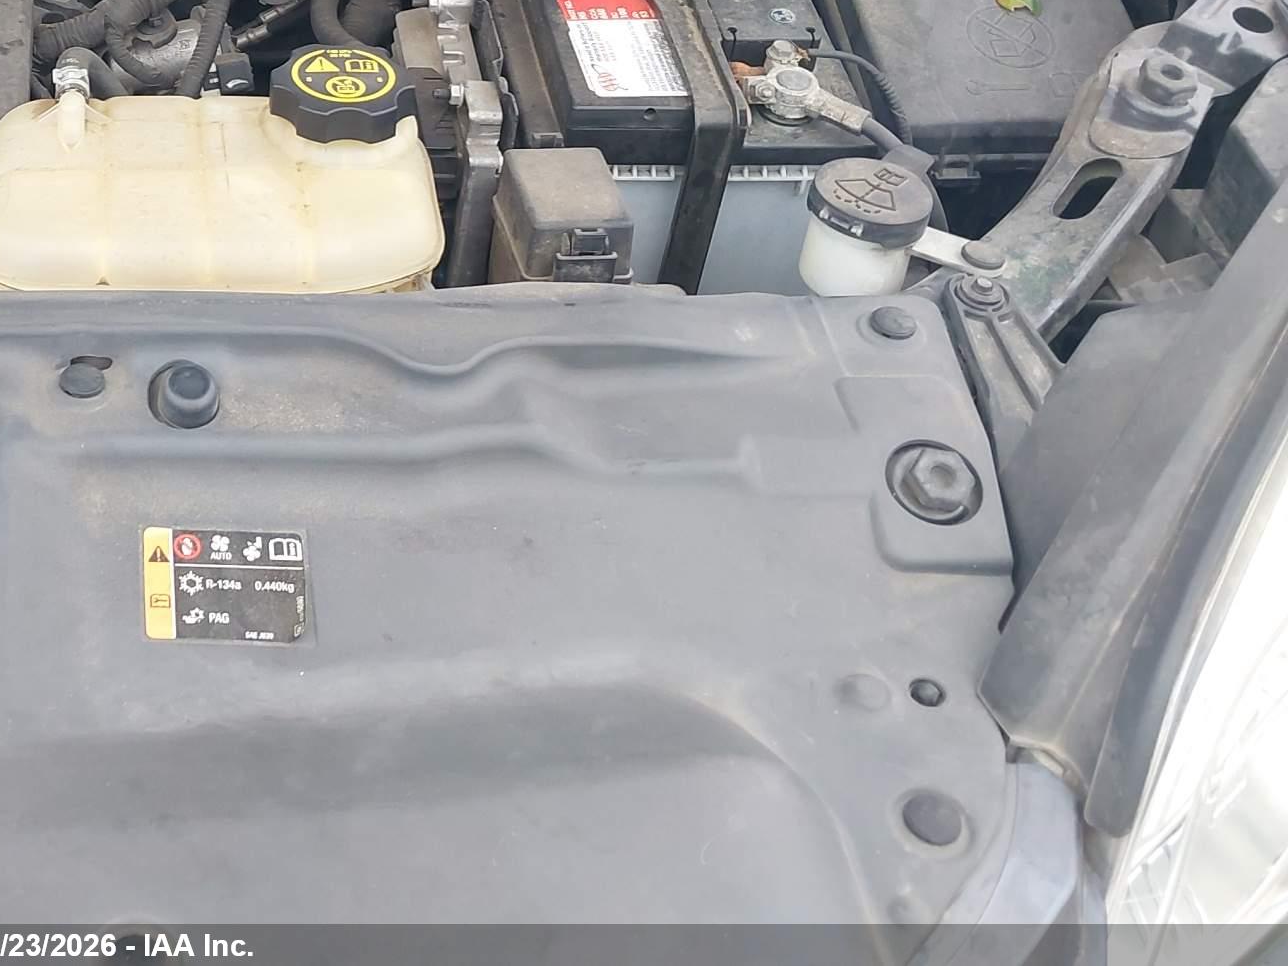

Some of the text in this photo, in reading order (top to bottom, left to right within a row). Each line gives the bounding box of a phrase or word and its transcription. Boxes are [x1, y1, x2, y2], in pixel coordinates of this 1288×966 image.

[211, 552, 232, 560] AUTO
[206, 579, 295, 594] R-134a 0.440kg
[208, 612, 230, 624] PAG
